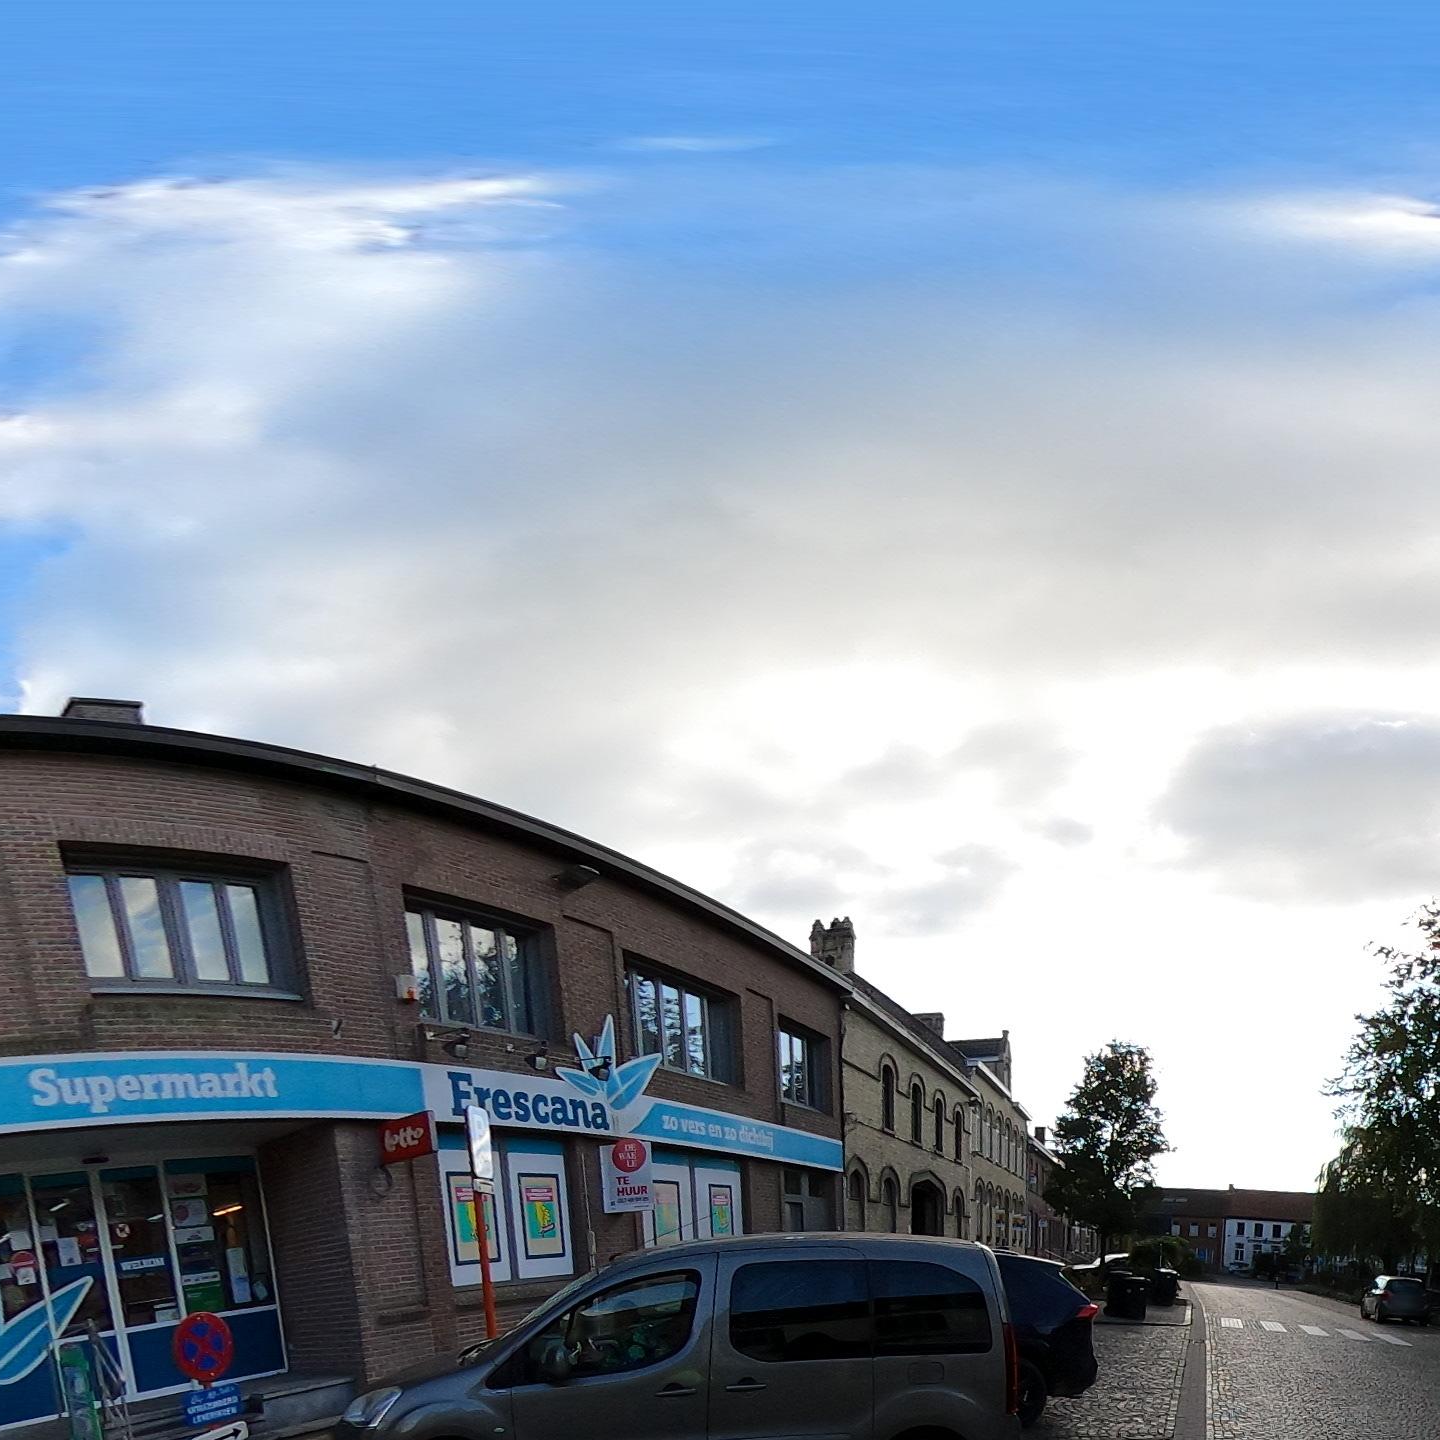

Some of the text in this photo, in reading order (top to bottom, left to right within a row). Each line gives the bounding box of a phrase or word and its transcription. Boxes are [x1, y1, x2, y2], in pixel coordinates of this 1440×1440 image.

[29, 1062, 279, 1114] Supermarkt
[447, 1071, 610, 1131] Frescana
[383, 1125, 425, 1152] lotto
[661, 1115, 678, 1131] zo
[680, 1117, 707, 1136] vers
[707, 1123, 724, 1138] en
[724, 1126, 738, 1141] zo
[616, 1176, 630, 1186] TE
[617, 1185, 648, 1197] HUUR
